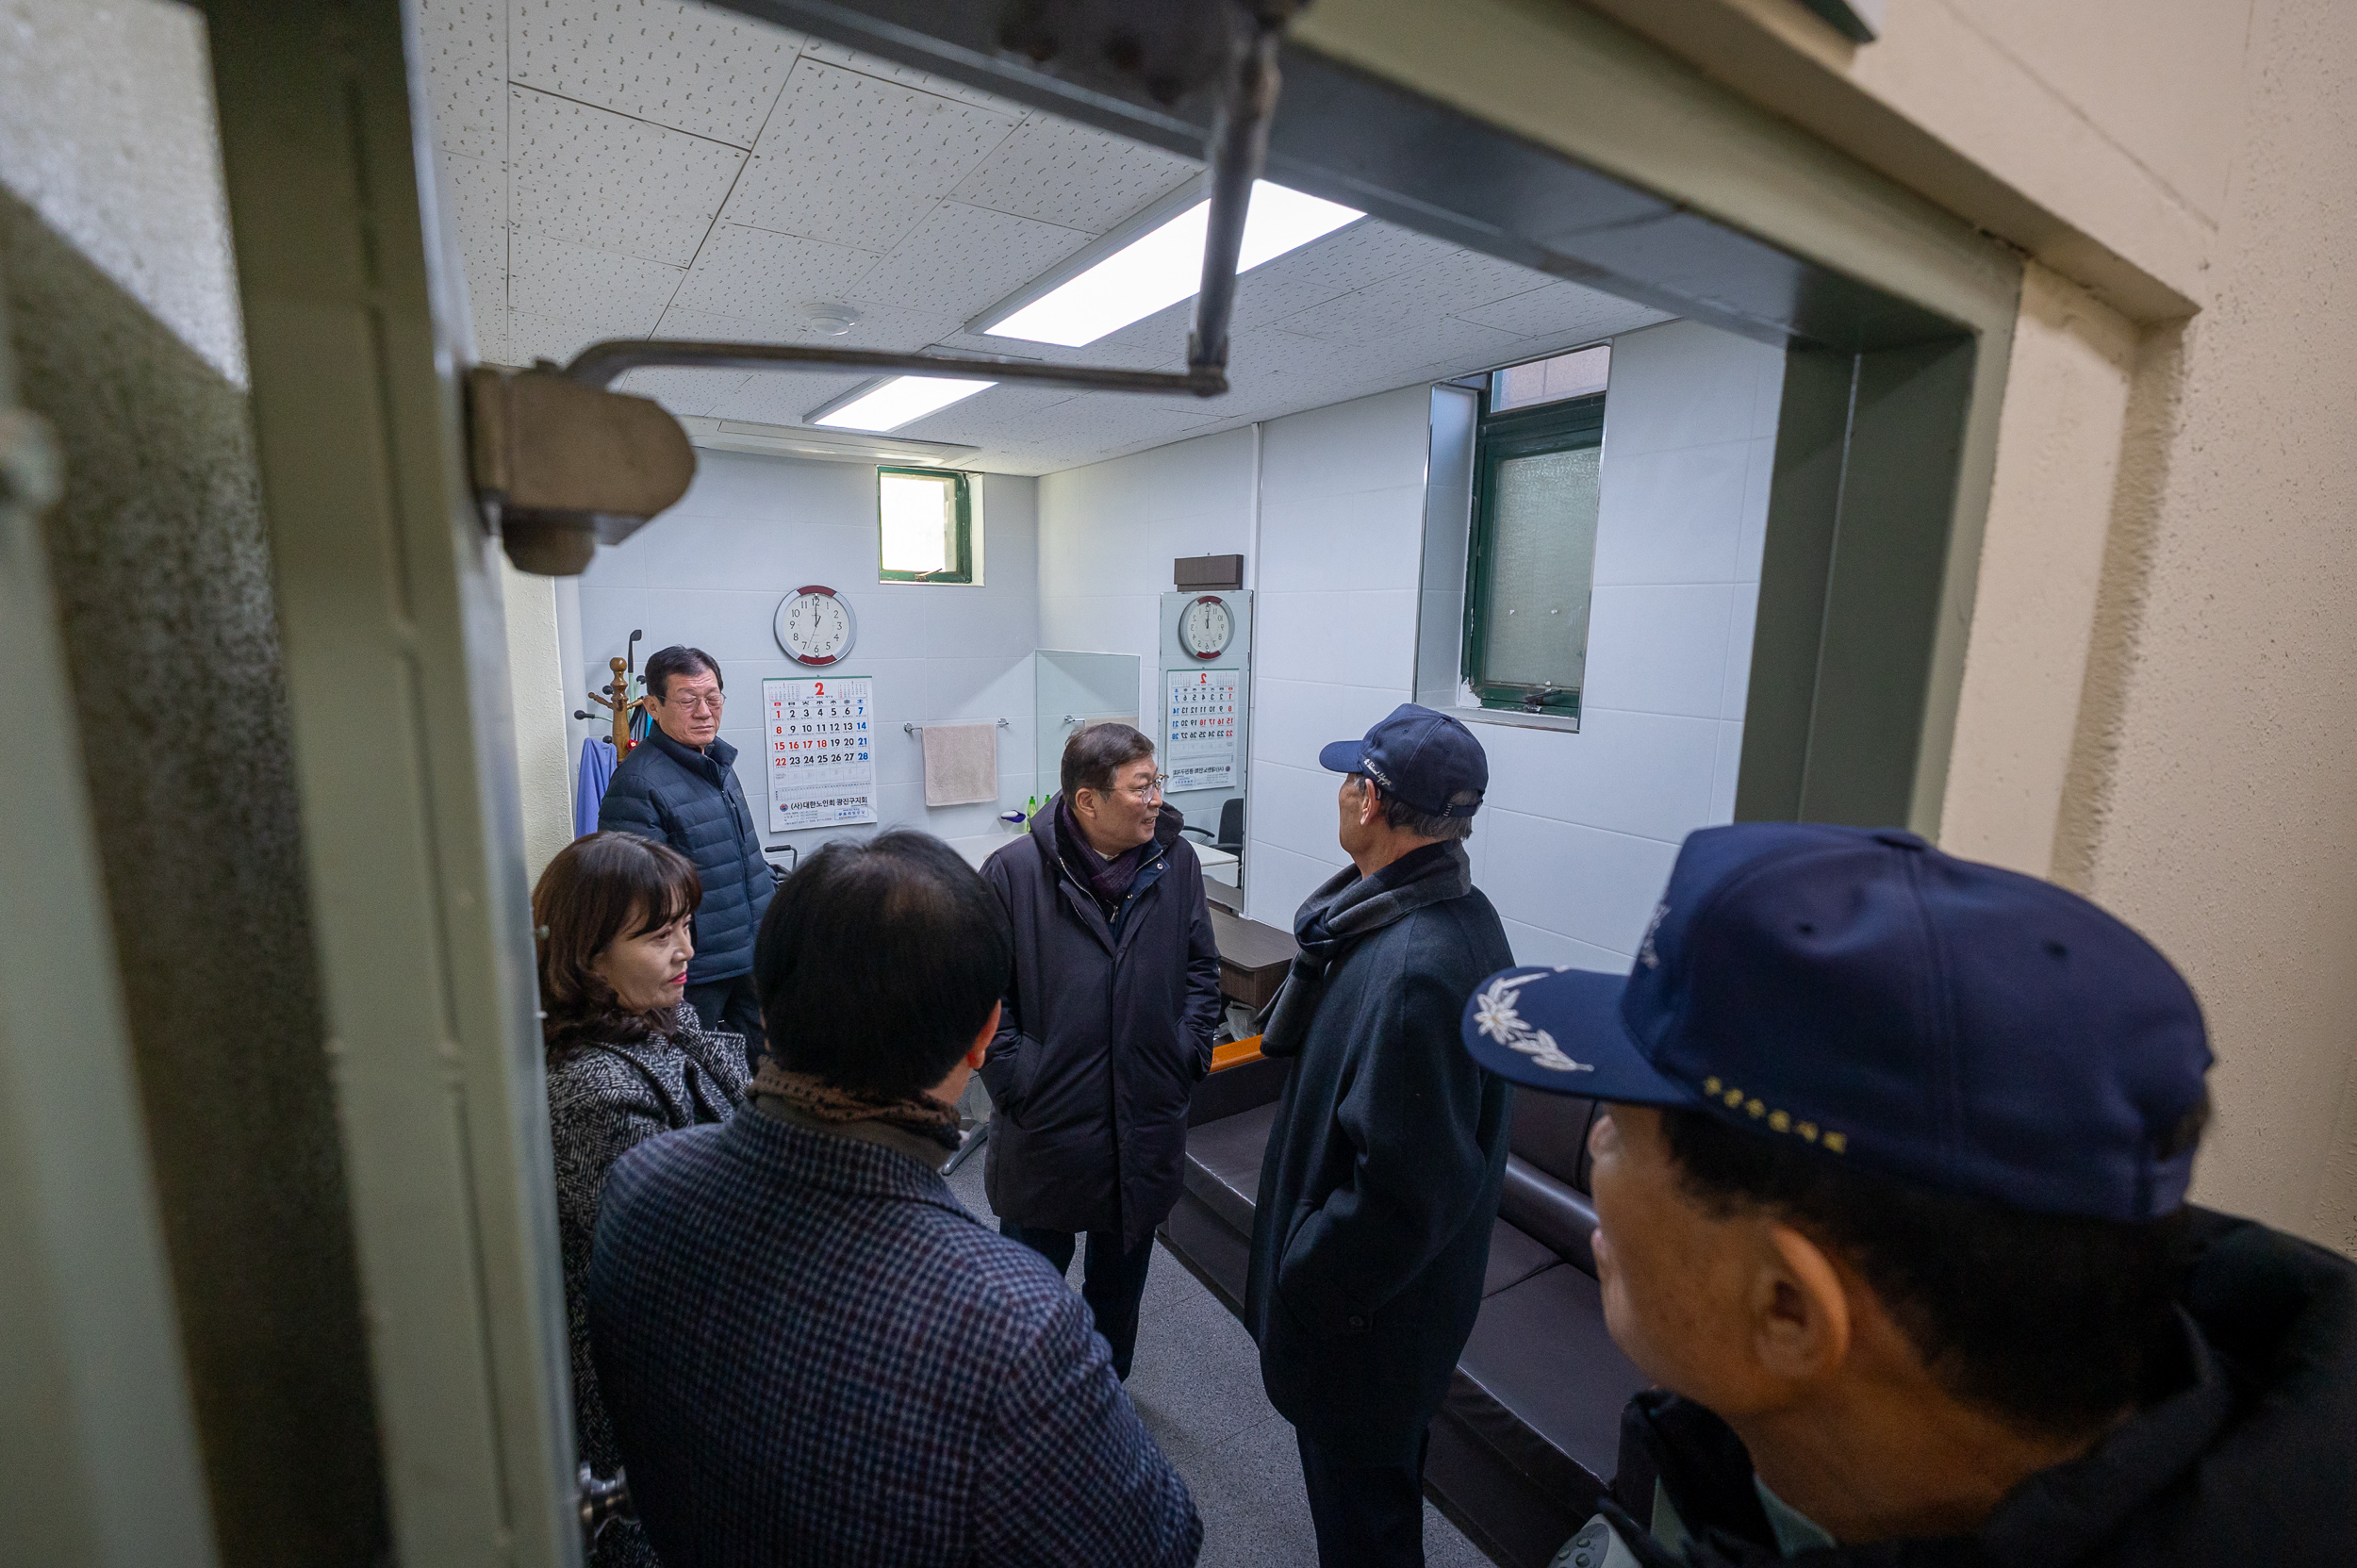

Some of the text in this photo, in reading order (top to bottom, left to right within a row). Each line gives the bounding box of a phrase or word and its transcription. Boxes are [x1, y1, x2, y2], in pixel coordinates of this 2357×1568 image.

[801, 601, 808, 609] 11
[812, 598, 819, 606] 12
[792, 609, 799, 618] 10
[834, 610, 839, 619] 2
[790, 620, 795, 629] 9
[794, 633, 799, 641] 8
[802, 641, 807, 650] 7
[815, 683, 825, 695] 2
[776, 710, 781, 718] 1
[803, 709, 809, 718] 3
[790, 725, 796, 734] 9
[802, 724, 812, 733] 10
[843, 722, 852, 731] 13
[774, 742, 785, 751] 15
[789, 741, 799, 750] 16
[802, 740, 813, 749] 17
[816, 739, 827, 748] 18
[831, 738, 840, 747] 19
[858, 737, 867, 746] 21
[775, 758, 786, 767] 22
[790, 799, 835, 810] (사)대한노인회
[836, 796, 867, 807] 광진구지회
